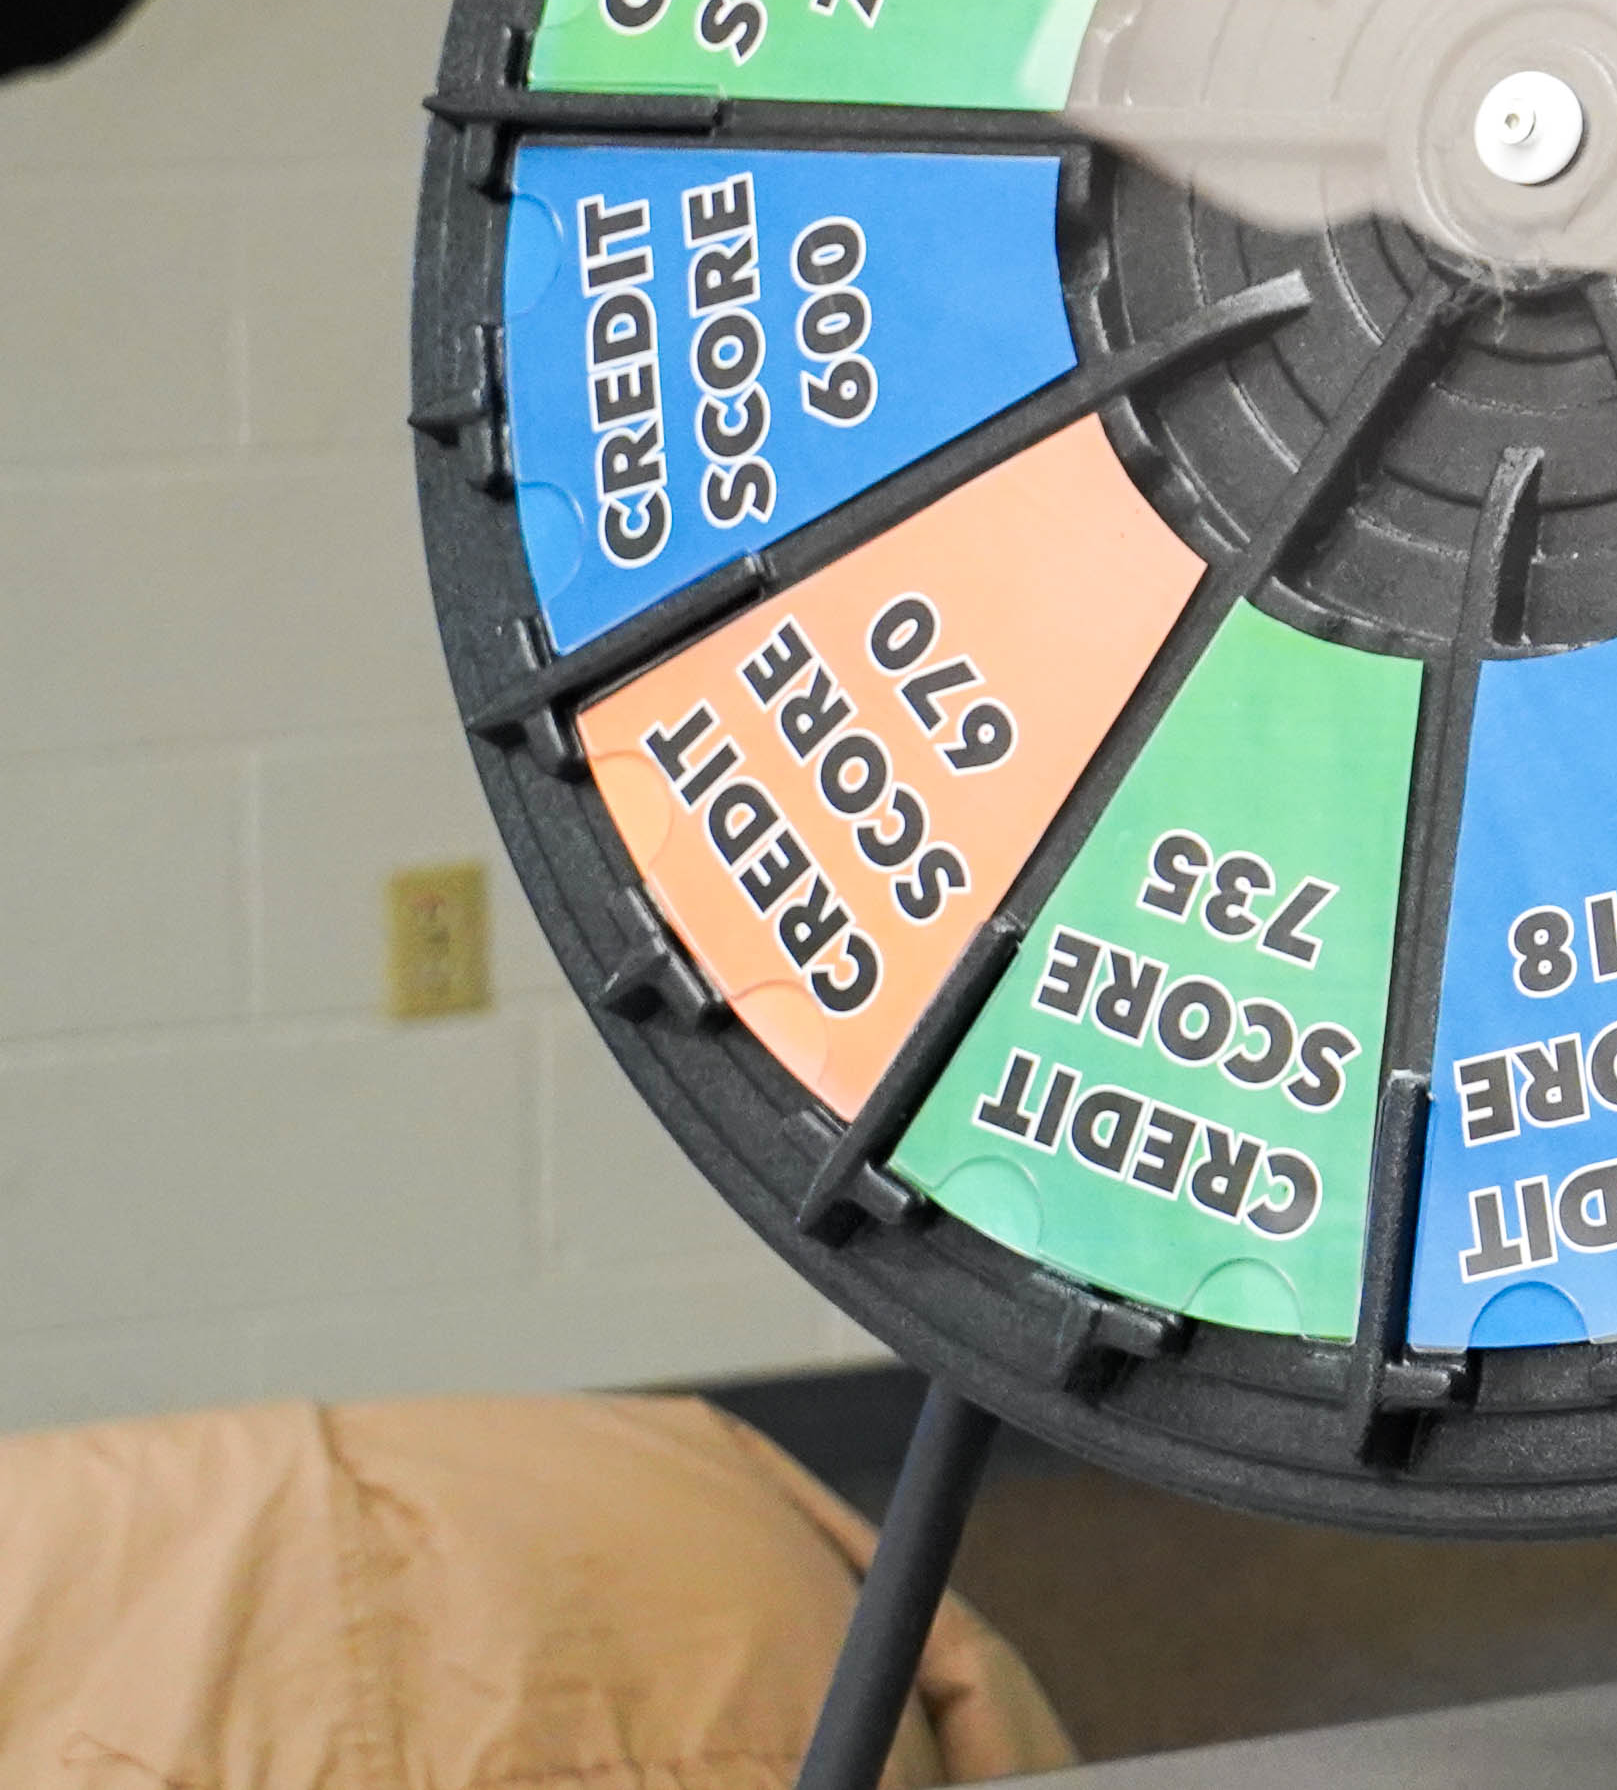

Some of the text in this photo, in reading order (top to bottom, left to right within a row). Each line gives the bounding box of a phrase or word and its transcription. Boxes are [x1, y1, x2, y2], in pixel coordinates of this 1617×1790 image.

[581, 197, 668, 565] CREDIT
[686, 175, 774, 526] SCORE
[794, 218, 875, 424] 600
[741, 617, 969, 921] SCORE
[870, 594, 1015, 770] 670
[644, 702, 879, 1015] CREDIT
[1140, 831, 1337, 966] 735
[1035, 927, 1358, 1110] SCORE
[978, 1054, 1320, 1237] CREDIT
